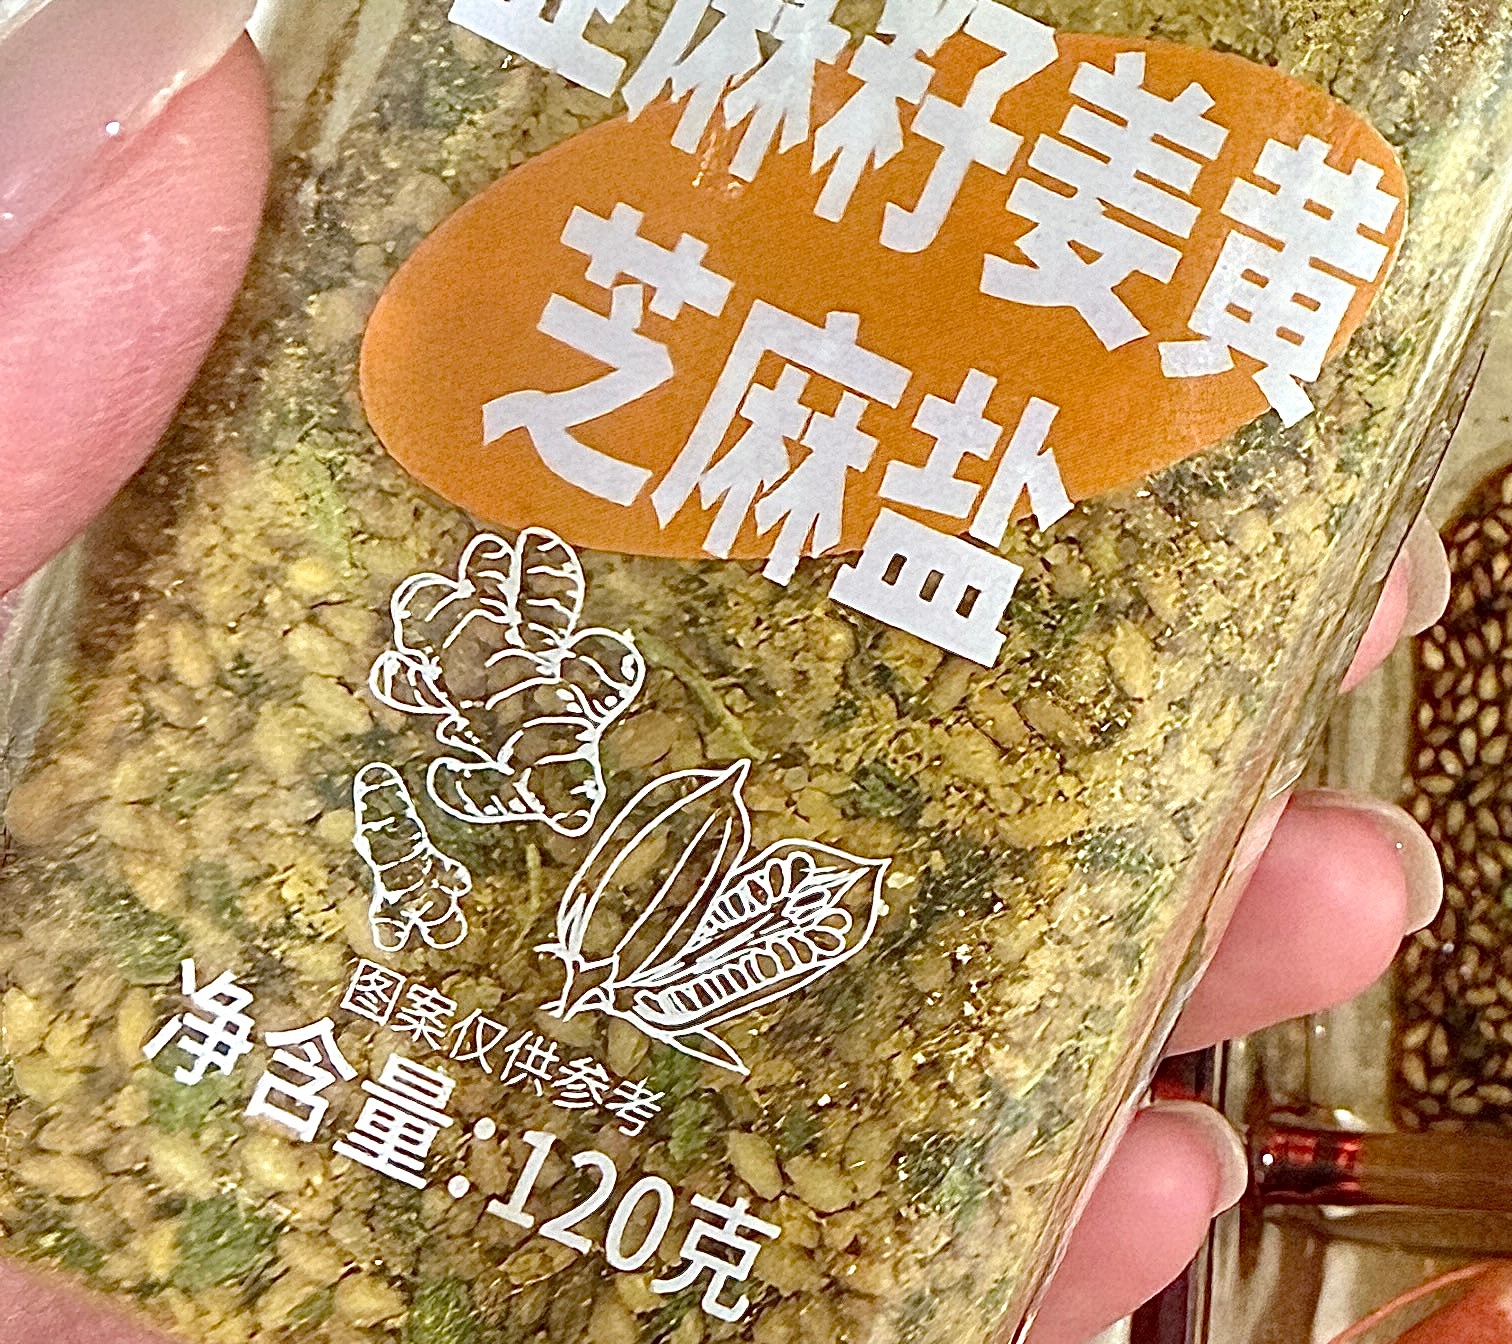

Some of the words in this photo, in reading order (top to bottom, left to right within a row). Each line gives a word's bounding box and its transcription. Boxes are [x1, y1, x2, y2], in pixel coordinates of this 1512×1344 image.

[481, 201, 1075, 668] 芝麻盐
[338, 959, 663, 1137] 图案仅供参考
